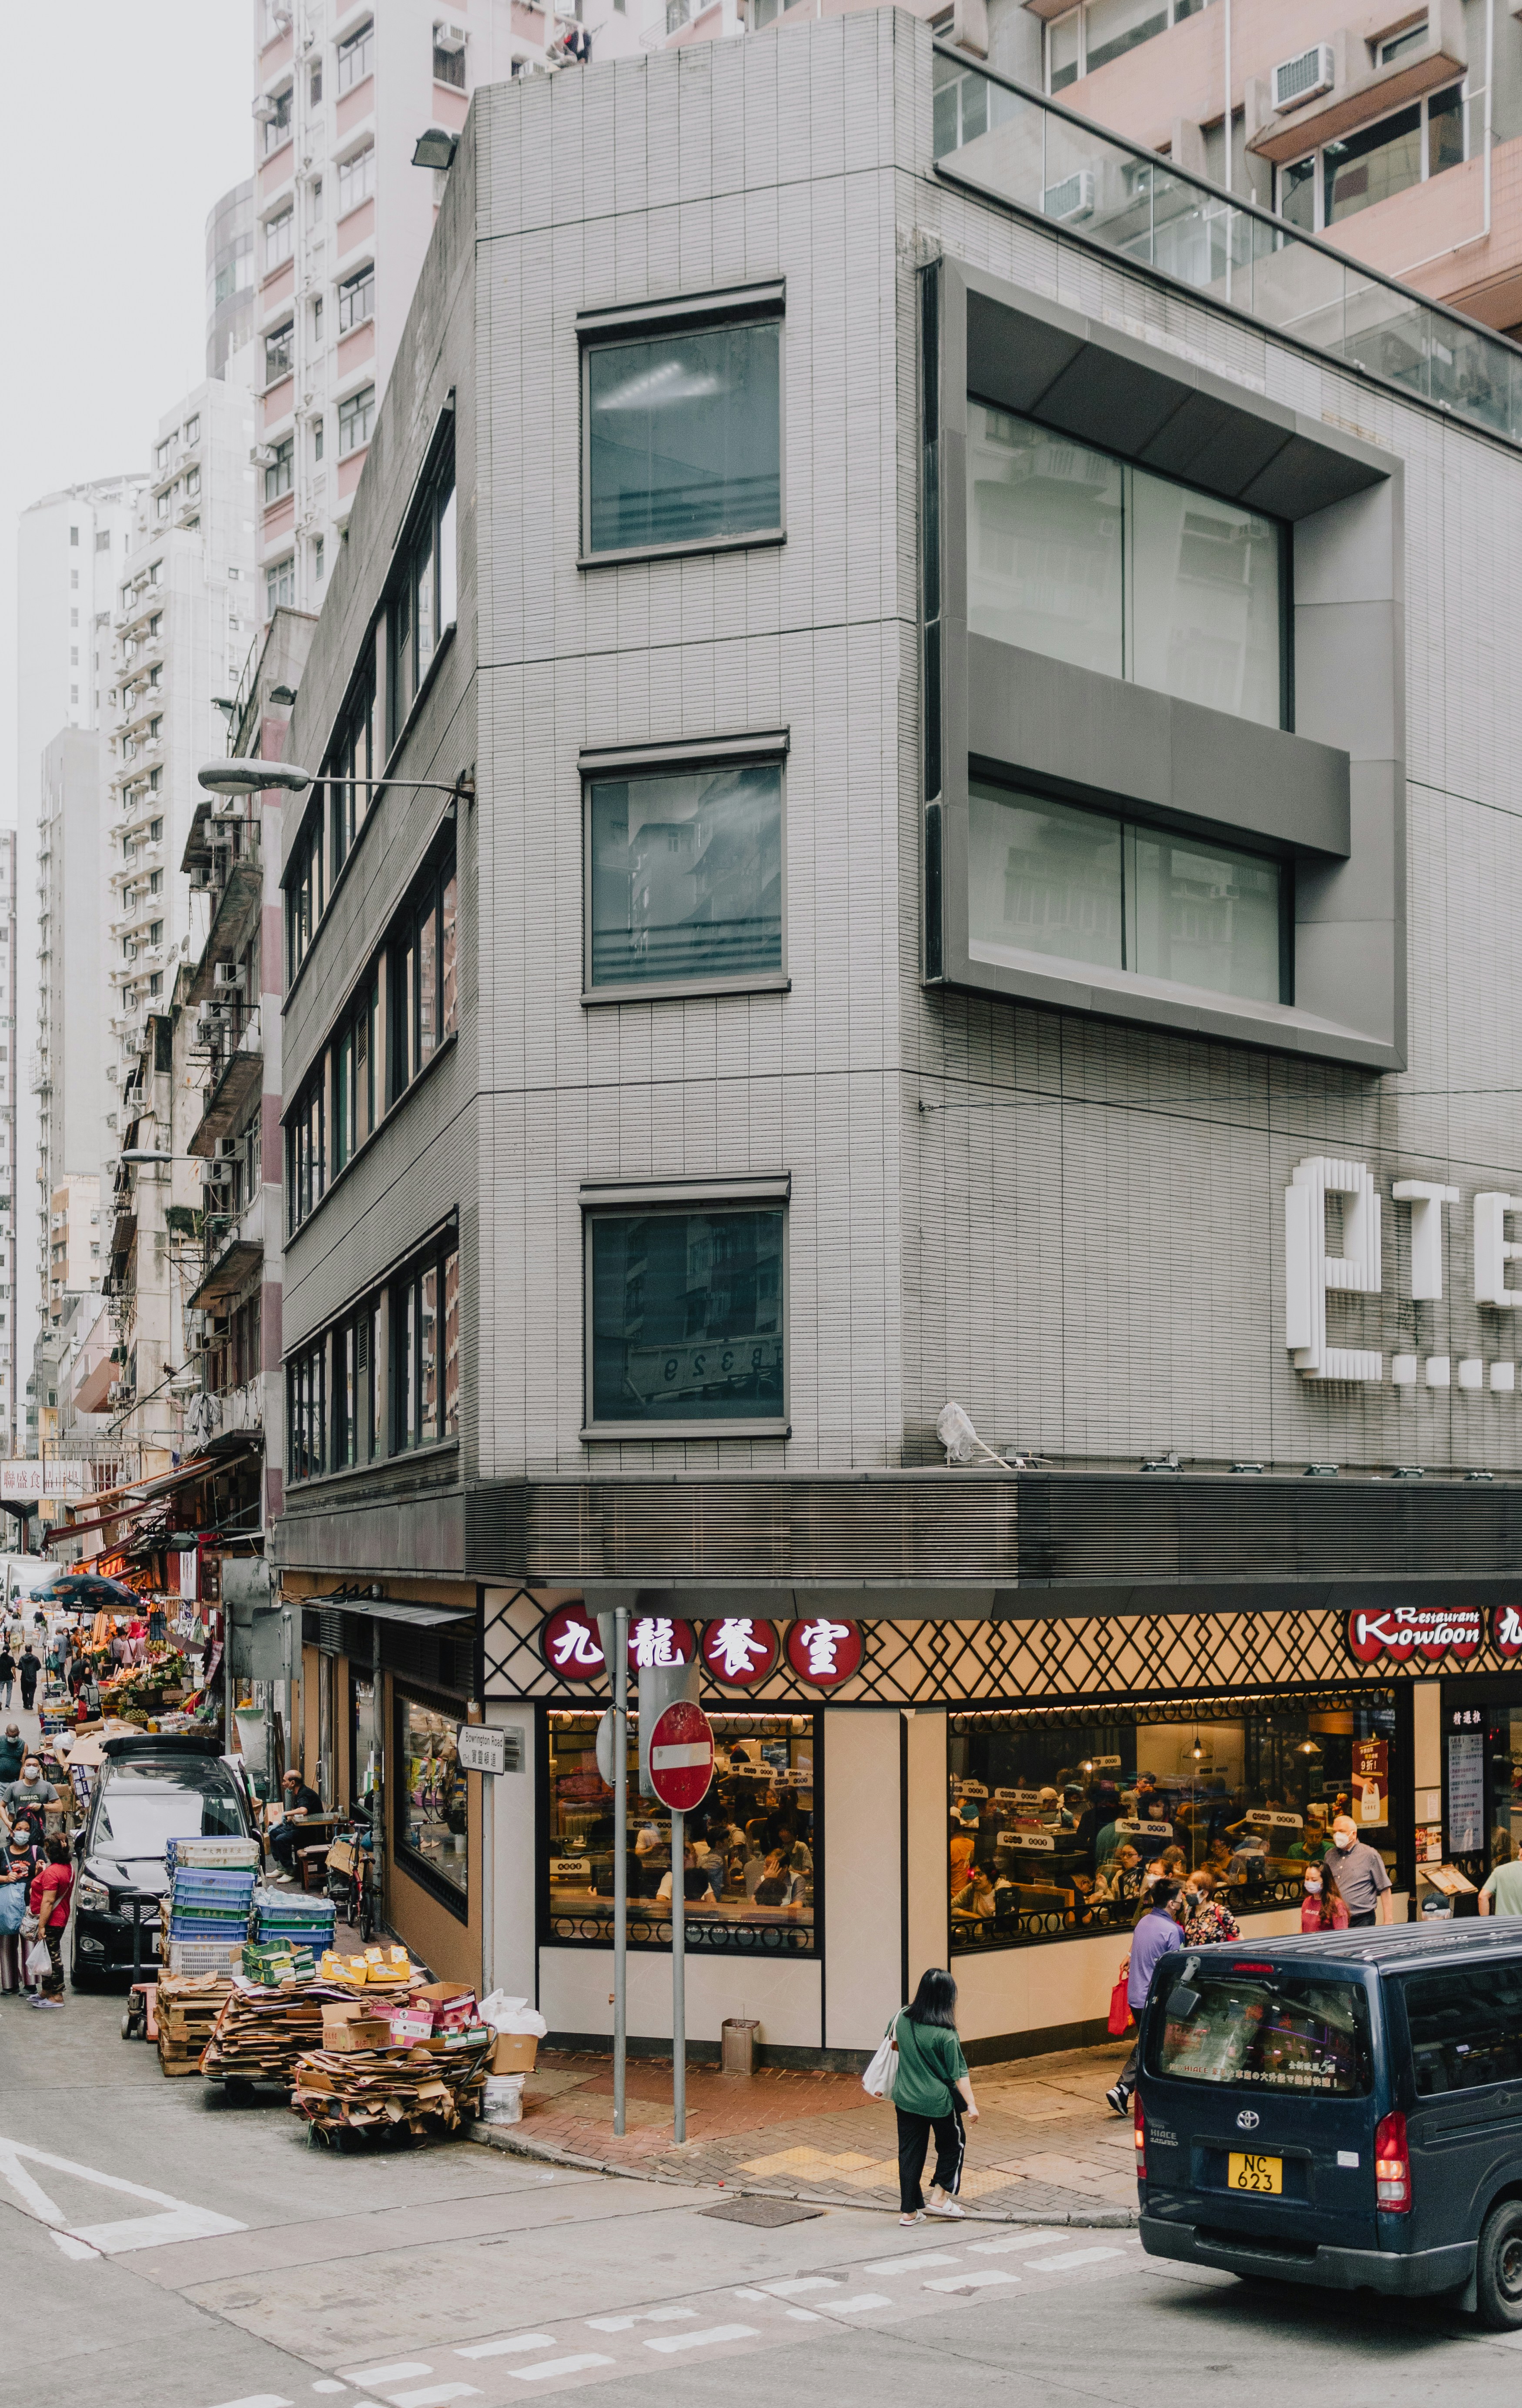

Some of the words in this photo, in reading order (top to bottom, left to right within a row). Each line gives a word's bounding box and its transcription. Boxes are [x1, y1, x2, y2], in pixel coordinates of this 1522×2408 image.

[1395, 1607, 1479, 1624] Restaurant
[1356, 1613, 1479, 1645] Kowloon
[553, 1618, 849, 1676] 九龍餐室
[465, 1732, 490, 1746] Bowrington
[492, 1735, 503, 1747] Road
[1184, 2065, 1208, 2074] HIACE
[1151, 2129, 1177, 2140] HIACE
[1244, 2154, 1267, 2173] NC
[1238, 2171, 1273, 2191] 623
